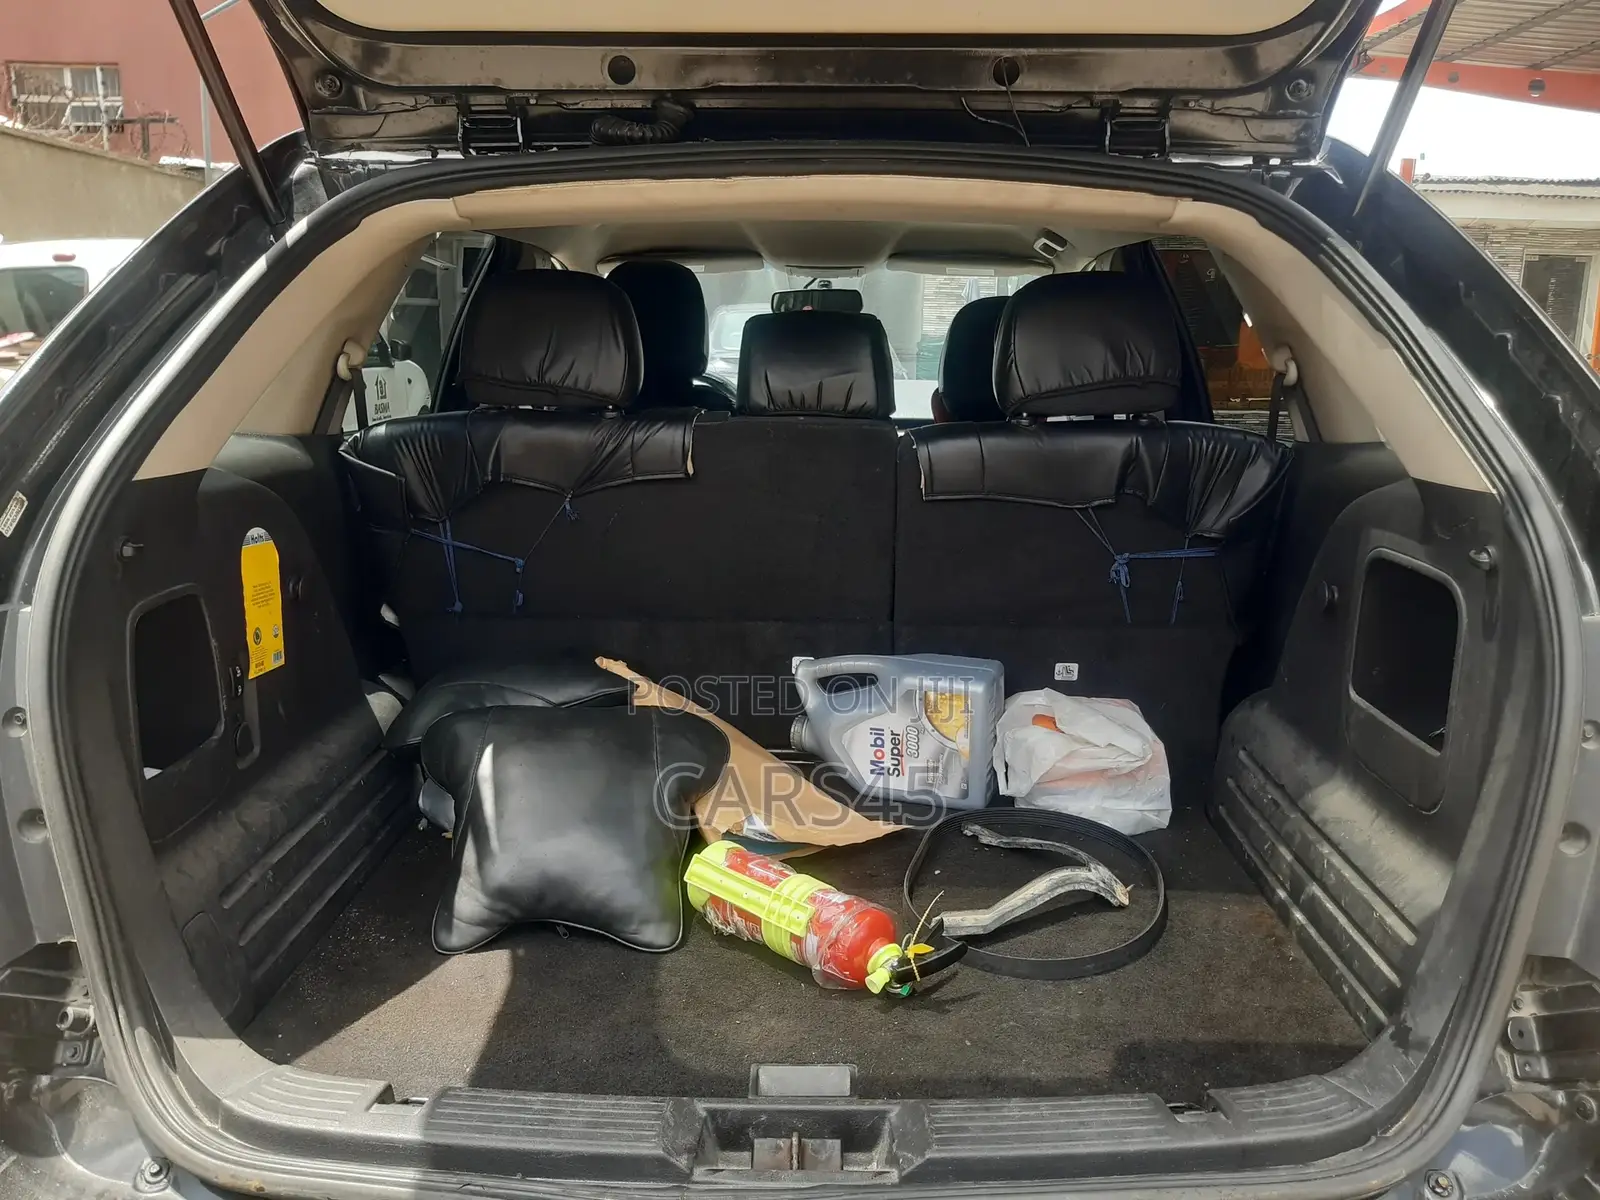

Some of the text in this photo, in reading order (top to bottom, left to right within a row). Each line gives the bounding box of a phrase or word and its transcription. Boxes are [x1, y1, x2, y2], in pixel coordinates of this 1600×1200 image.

[870, 727, 885, 776] Mobil
[887, 729, 904, 778] Super
[906, 725, 920, 759] 3000
